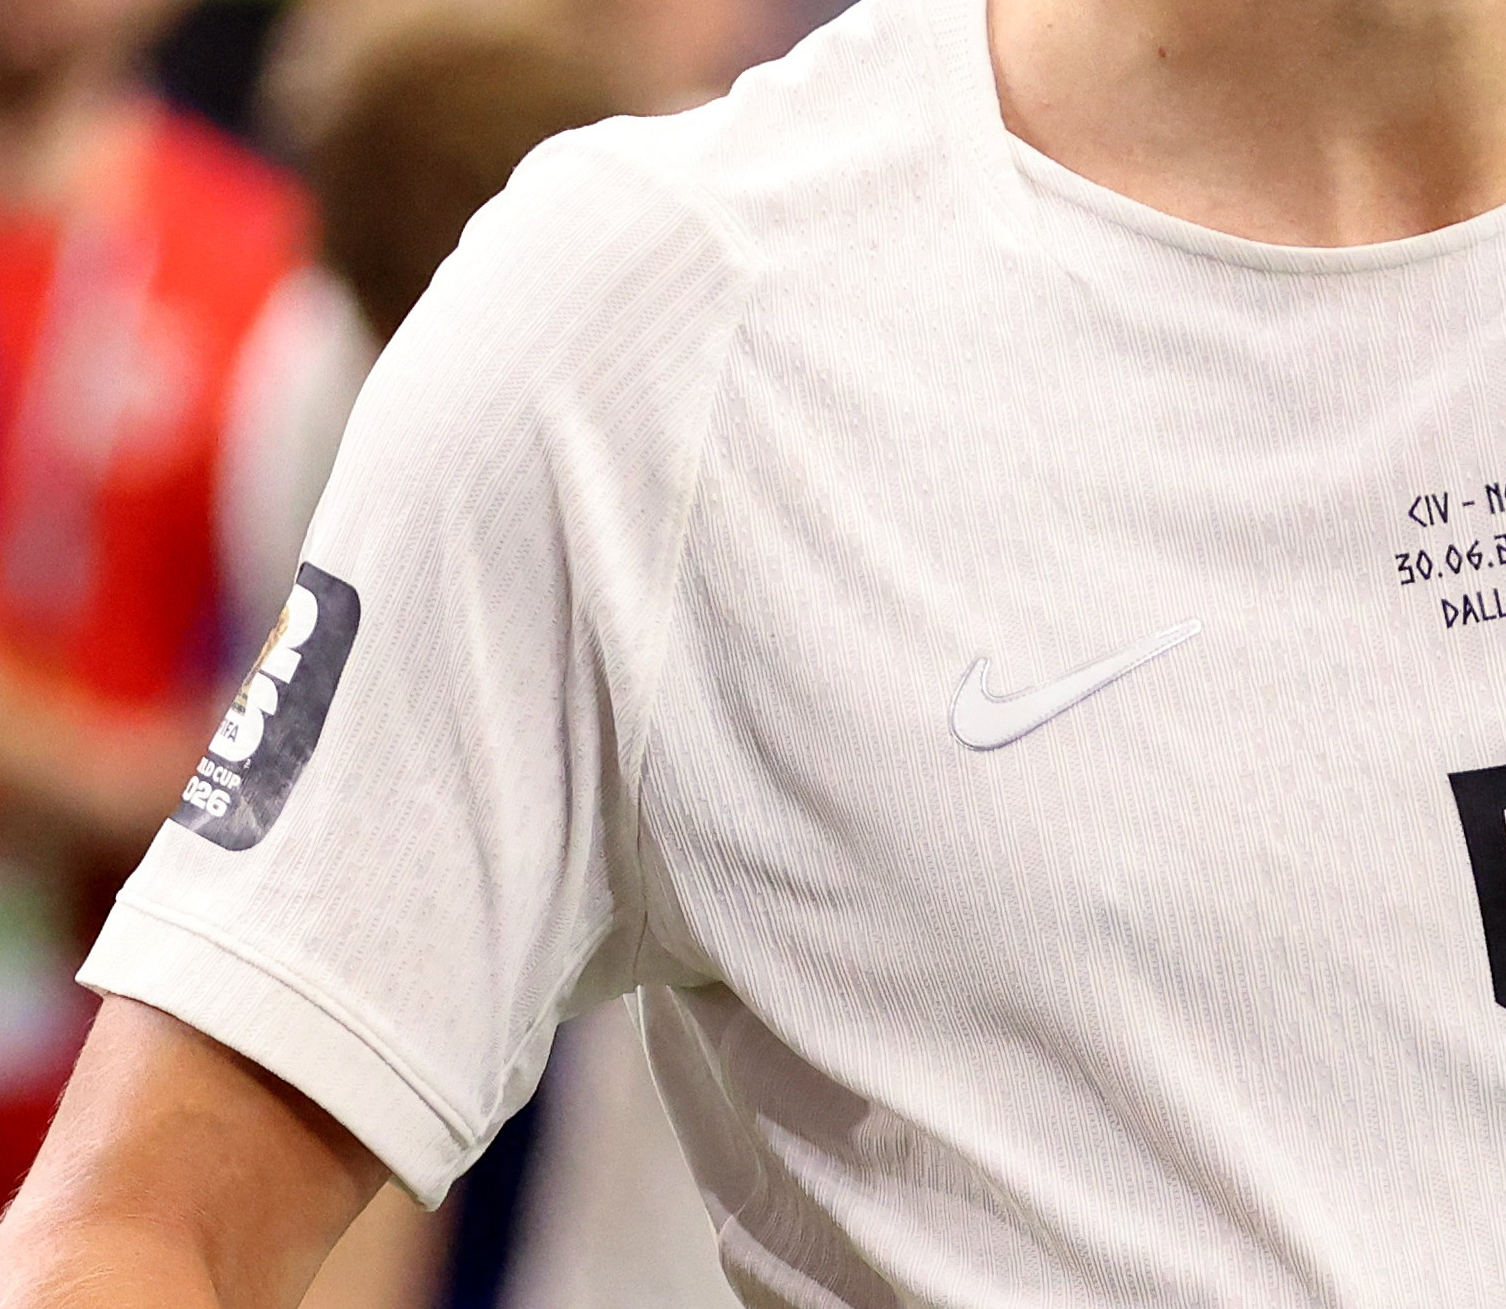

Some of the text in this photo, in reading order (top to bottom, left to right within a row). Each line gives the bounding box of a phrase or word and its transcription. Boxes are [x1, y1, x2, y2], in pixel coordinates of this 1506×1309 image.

[1408, 491, 1449, 528] CIV
[212, 766, 242, 789] CUP
[182, 776, 232, 818] 026
